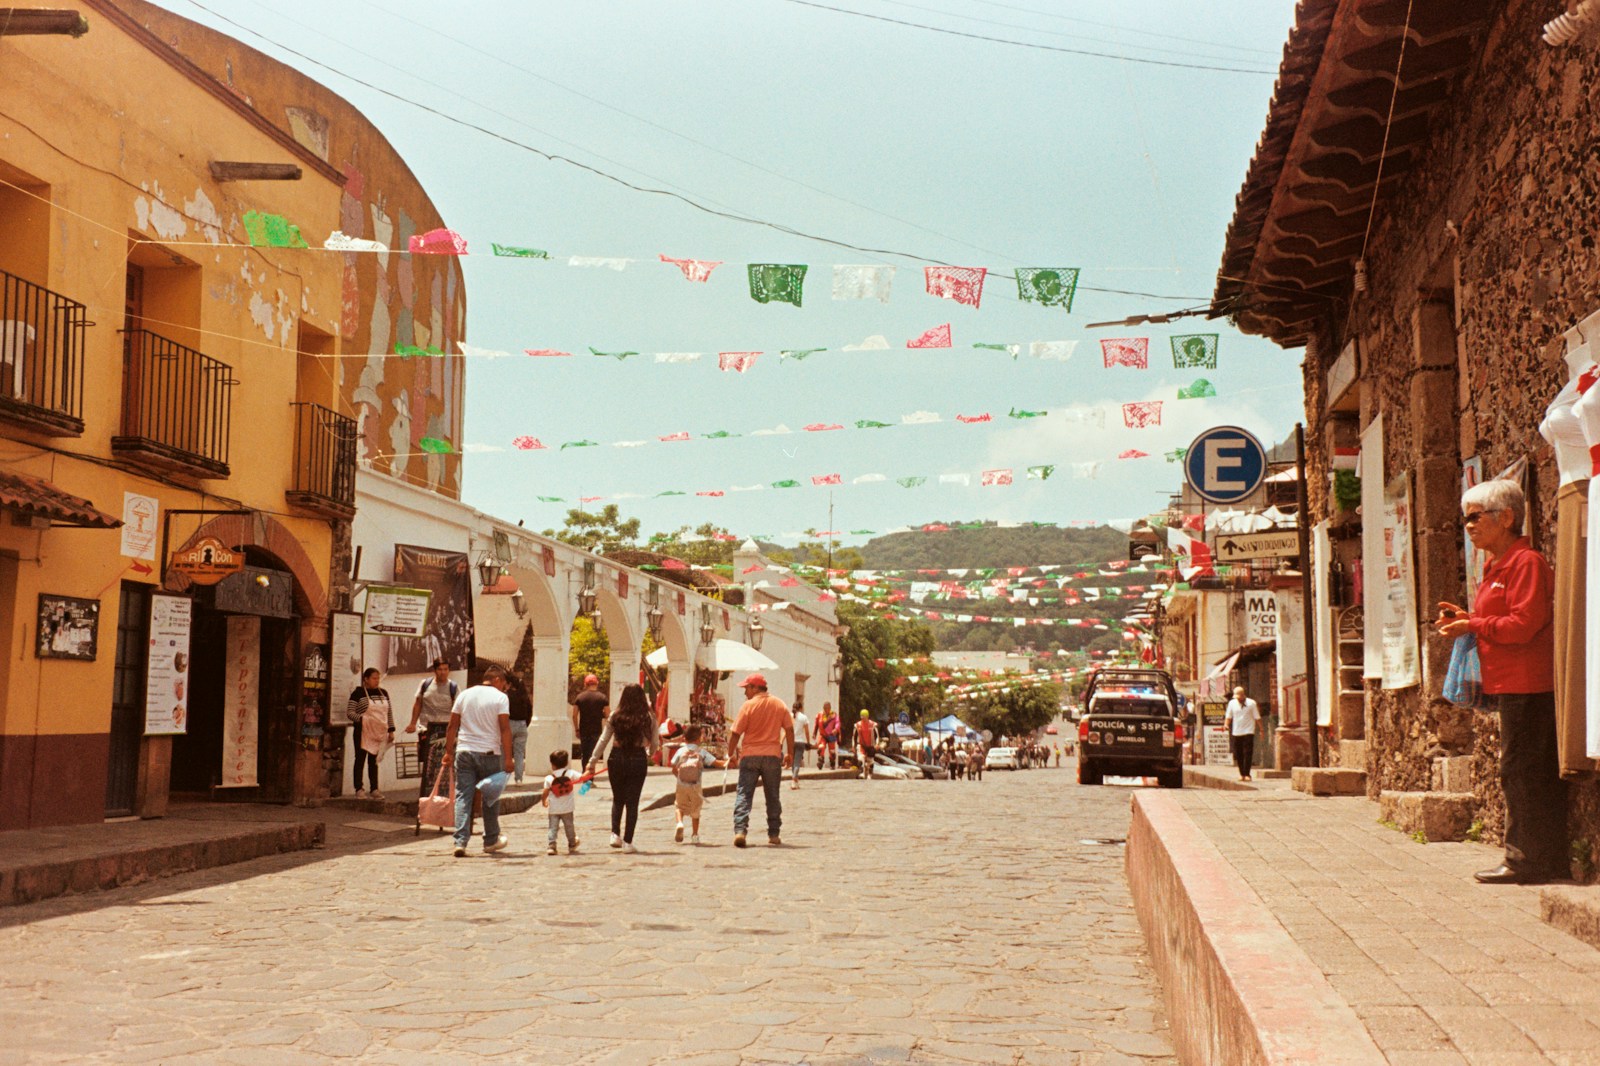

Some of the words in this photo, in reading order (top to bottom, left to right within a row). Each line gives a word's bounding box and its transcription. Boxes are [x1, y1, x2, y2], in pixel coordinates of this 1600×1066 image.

[1204, 438, 1247, 491] E
[1242, 540, 1264, 552] SANTO
[1264, 538, 1297, 551] DOMINGO
[417, 552, 448, 568] CONARTE
[1091, 720, 1126, 729] POLICÍA
[1141, 722, 1169, 731] SSPC
